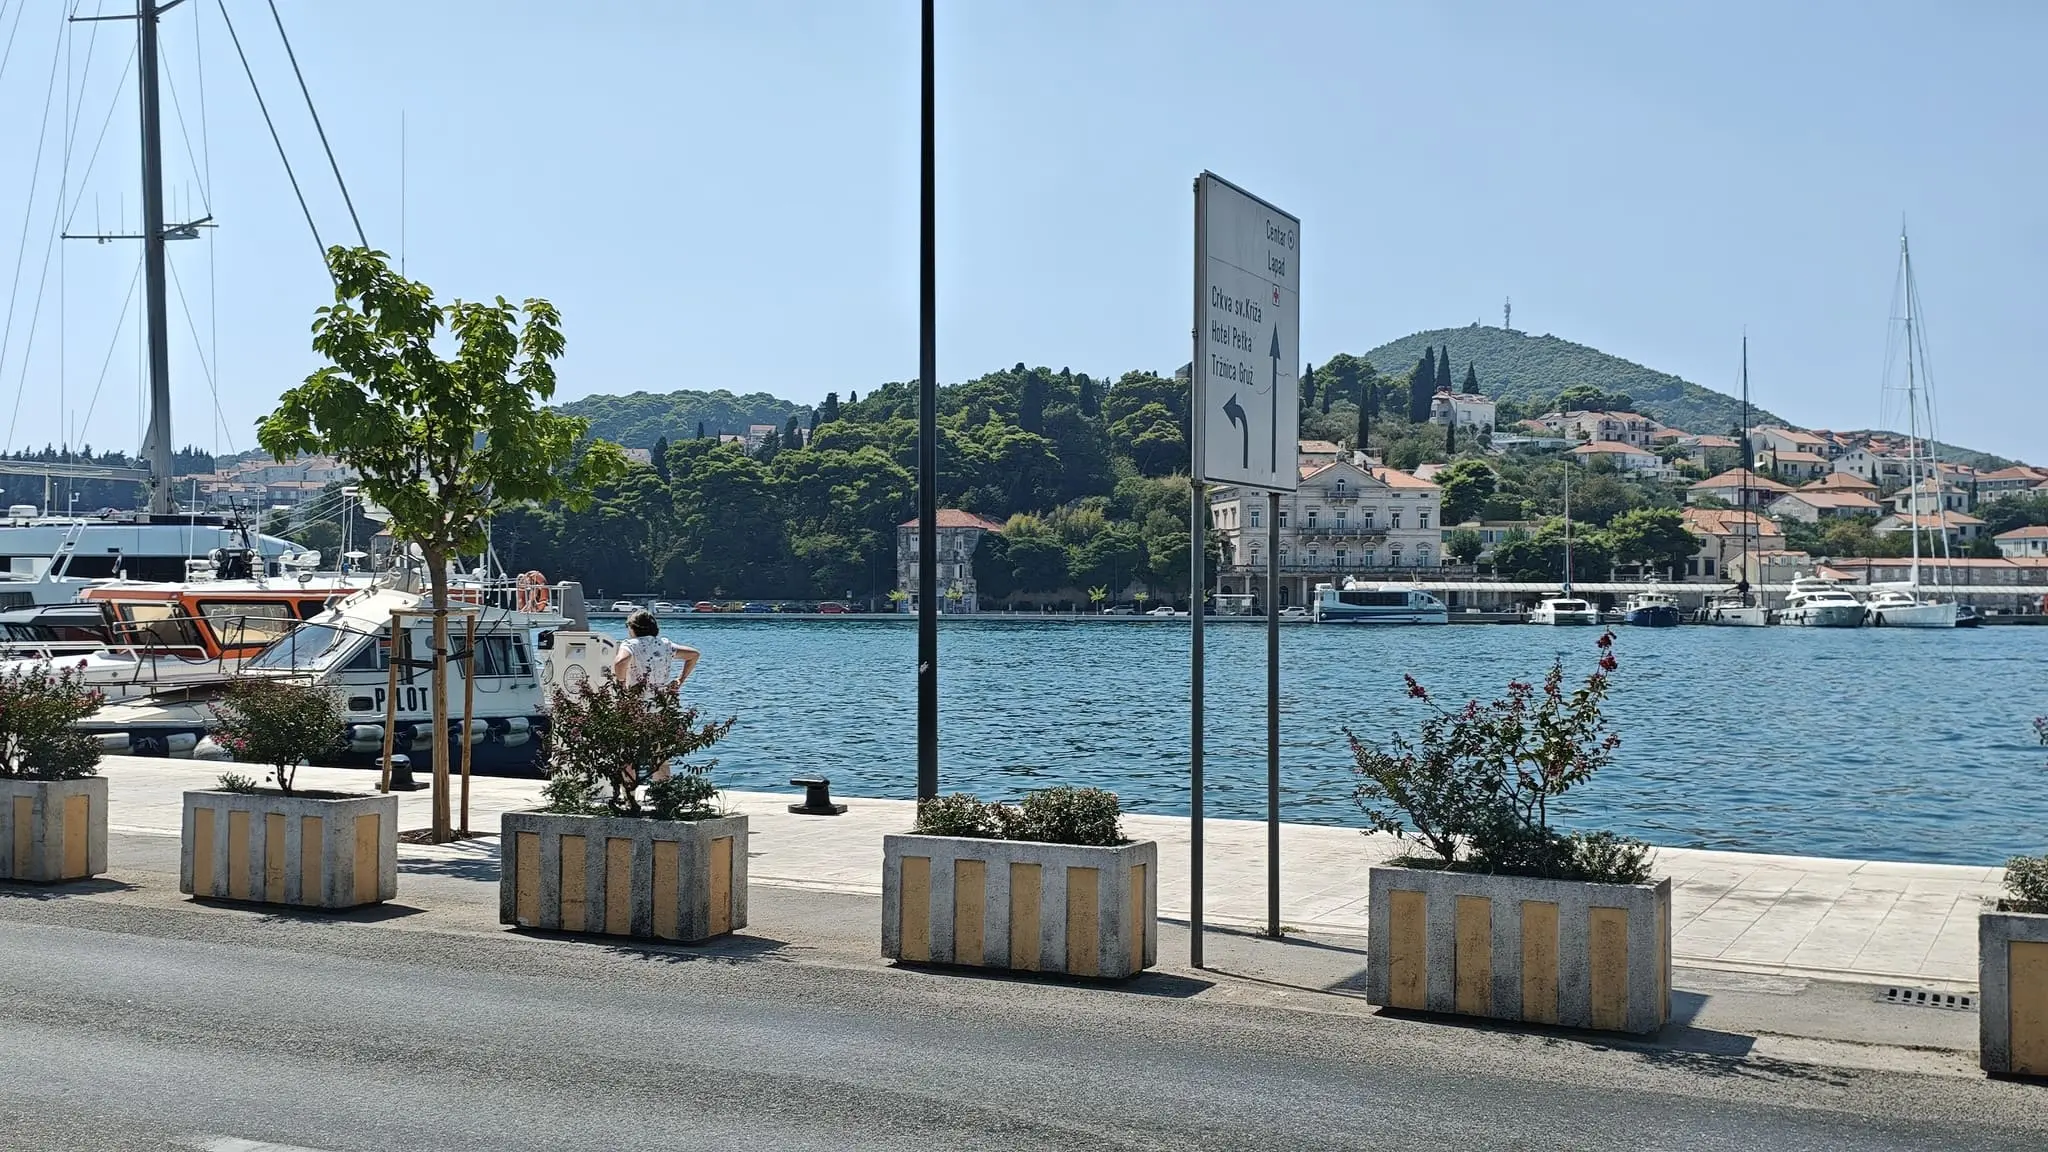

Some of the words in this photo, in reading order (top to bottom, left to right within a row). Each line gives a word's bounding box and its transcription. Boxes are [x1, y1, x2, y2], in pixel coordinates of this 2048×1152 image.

[1265, 219, 1286, 247] Centar
[1267, 249, 1285, 278] Lapad
[1211, 285, 1232, 313] Crkva
[1211, 319, 1230, 346] Hotel
[1233, 326, 1252, 353] Petka
[1211, 353, 1236, 381] Tržnica
[375, 686, 428, 712] PLOT
